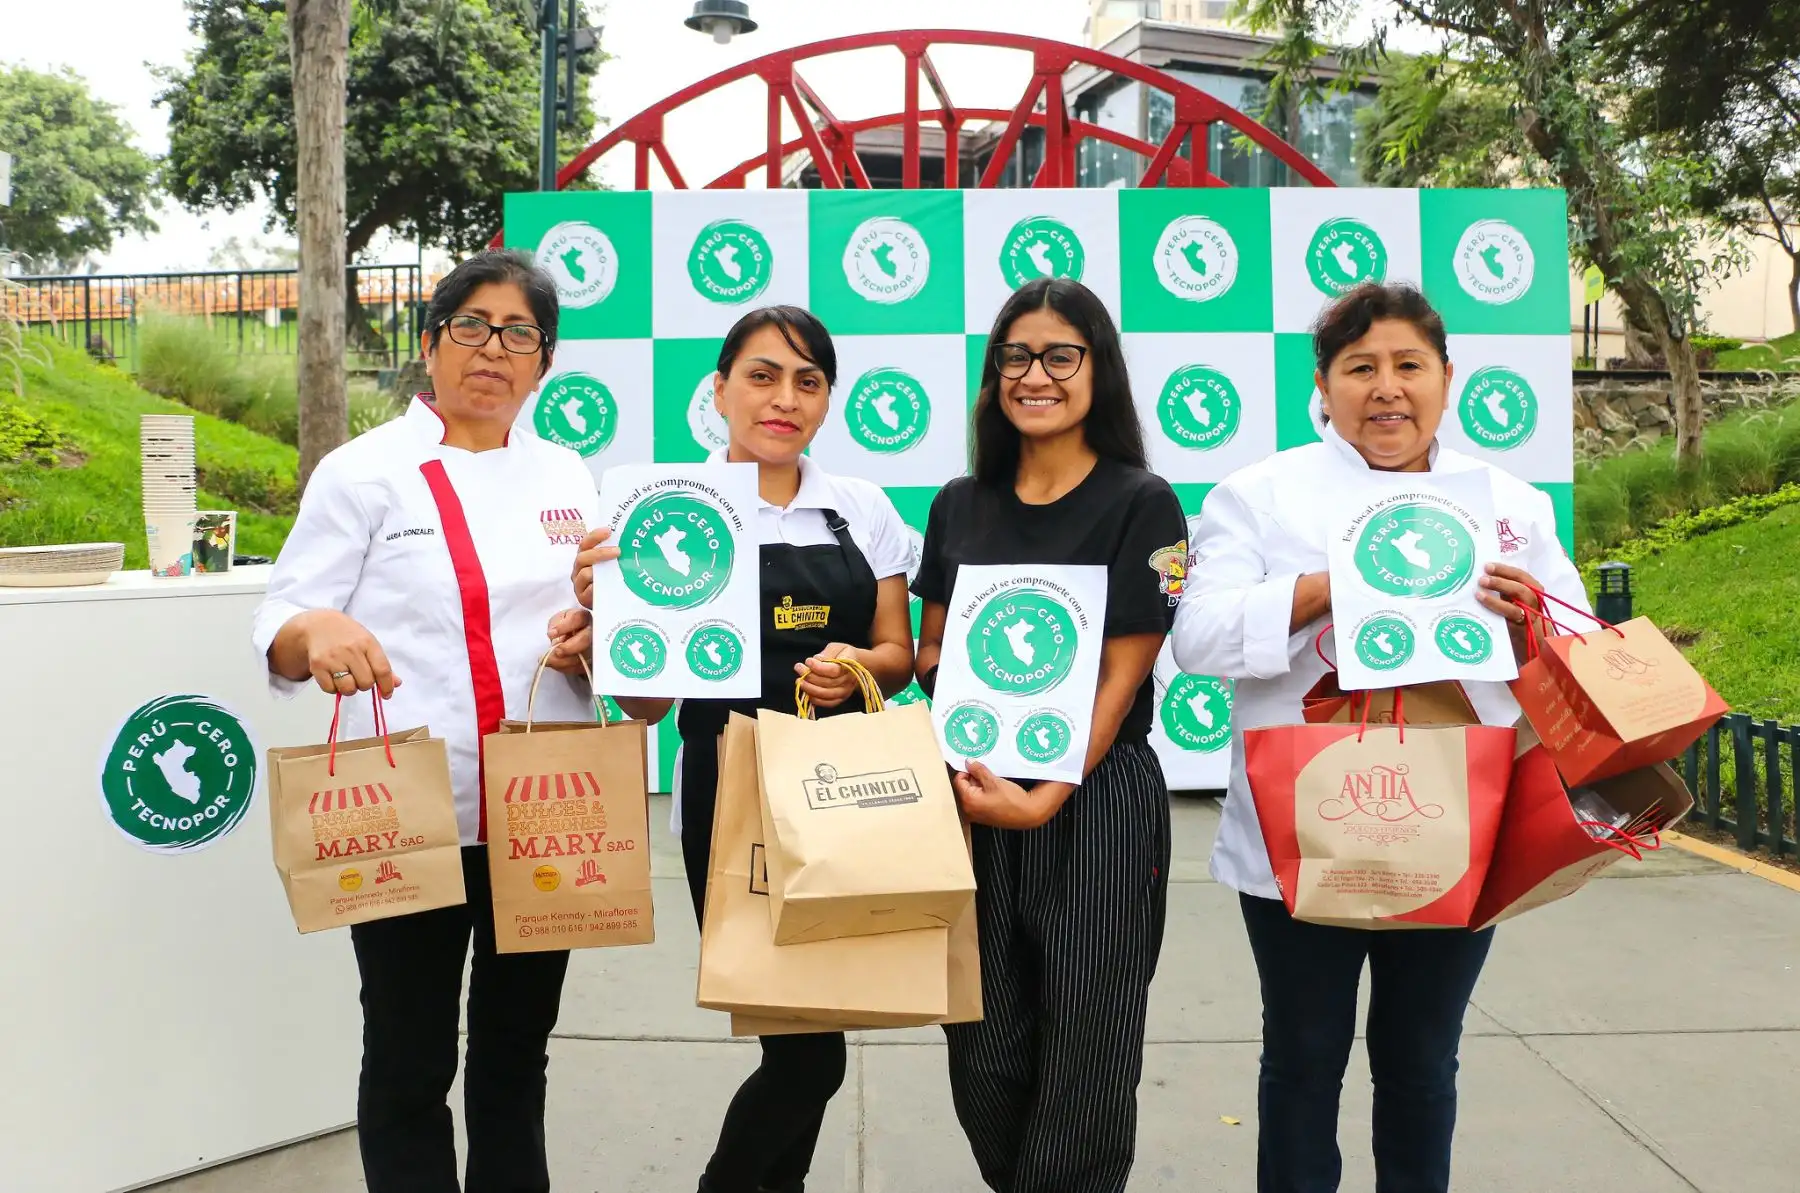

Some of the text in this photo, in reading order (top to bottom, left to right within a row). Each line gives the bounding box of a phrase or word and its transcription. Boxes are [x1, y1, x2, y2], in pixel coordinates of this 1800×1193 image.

[544, 236, 608, 264] PERÚ CERO
[698, 231, 763, 262] PERÚ CERO
[854, 230, 919, 259] PERÚ CERO
[1009, 230, 1074, 259] PERÚ CERO
[1164, 229, 1228, 258] PERÚ CERO
[1316, 229, 1377, 259] PERÚ CERO
[1464, 232, 1524, 262] PERÚ CERO
[558, 279, 602, 298] CNOPOR
[702, 275, 758, 297] TECNOPOR
[859, 274, 915, 294] TECNOPOR
[1168, 272, 1224, 292] TECNOPOR
[1468, 275, 1521, 294] TECNOPOR
[544, 385, 608, 415] PERÚ CERO
[699, 388, 714, 411] PER
[855, 380, 920, 410] PERÚ CERO
[1167, 378, 1231, 407] PERÚ CERO
[1468, 378, 1529, 408] PERÚ CERO
[548, 429, 604, 450] TECNOPOR
[860, 424, 916, 445] TECNOPOR
[1171, 420, 1227, 441] TECNOPOR
[1471, 422, 1525, 442] TECNOPOR
[620, 488, 641, 511] local
[641, 483, 653, 493] se
[654, 478, 720, 499] compromete
[719, 496, 735, 518] con
[732, 515, 744, 532] un:
[631, 508, 720, 550] PERÚ CERO
[1342, 522, 1357, 543] Este
[1355, 505, 1375, 525] local
[1375, 498, 1386, 508] se
[1387, 493, 1453, 508] compromete
[1453, 504, 1470, 520] con
[403, 528, 435, 537] GONZALES
[548, 535, 584, 545] MAR
[1368, 517, 1459, 552] PERÚ CERO
[637, 569, 714, 597] TECNOPOR
[1376, 565, 1456, 588] TECNOPOR
[961, 576, 1089, 631] Este local se compromete con un:
[777, 611, 826, 624] EL CHINITO
[982, 602, 1064, 644] PERÚ CERO
[643, 634, 660, 653] CERO
[719, 634, 736, 653] CERO
[620, 659, 657, 675] TECNOPOR
[696, 662, 733, 676] TECNOPOR
[983, 655, 1055, 685] TECNOPOR
[1171, 680, 1233, 709] PERÚ CERO
[1174, 723, 1230, 744] TECNOPOR
[122, 719, 238, 772] PERÚ CERO
[815, 778, 910, 801] EL CHINITO
[130, 793, 231, 831] TECNOPOR
[506, 799, 605, 822] DULCES &
[508, 815, 608, 837] PICARONES
[315, 831, 425, 861] MARY SAC
[508, 832, 635, 860] MARY SAC
[330, 895, 353, 904] Parque
[515, 914, 548, 924] Parque
[551, 911, 586, 921] Kenndy
[594, 907, 639, 919] Miraflores
[534, 926, 550, 935] 988
[552, 925, 566, 933] 010
[589, 922, 604, 931] 942
[606, 921, 621, 930] 899
